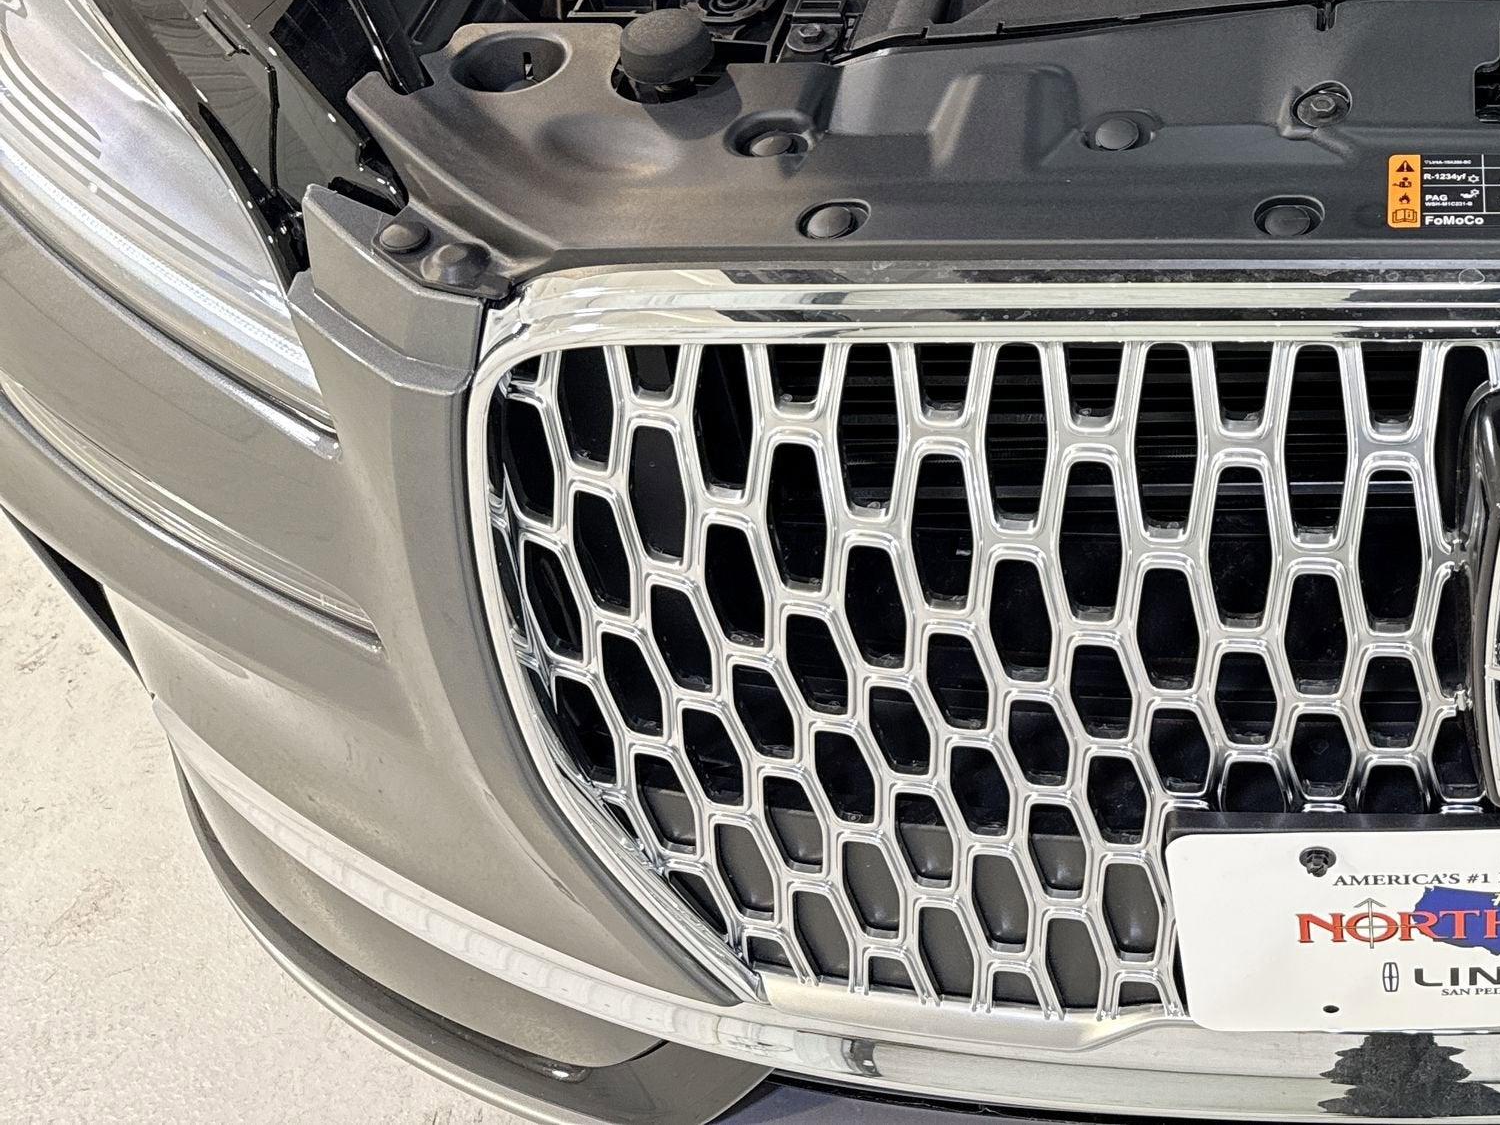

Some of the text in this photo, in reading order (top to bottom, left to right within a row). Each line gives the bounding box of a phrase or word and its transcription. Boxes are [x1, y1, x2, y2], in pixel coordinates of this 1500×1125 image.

[1423, 173, 1467, 182] R-1234yf
[1425, 194, 1448, 202] PAG
[1425, 215, 1485, 226] FoMoCo
[1467, 873, 1491, 884] #1
[1441, 987, 1472, 996] SAN
